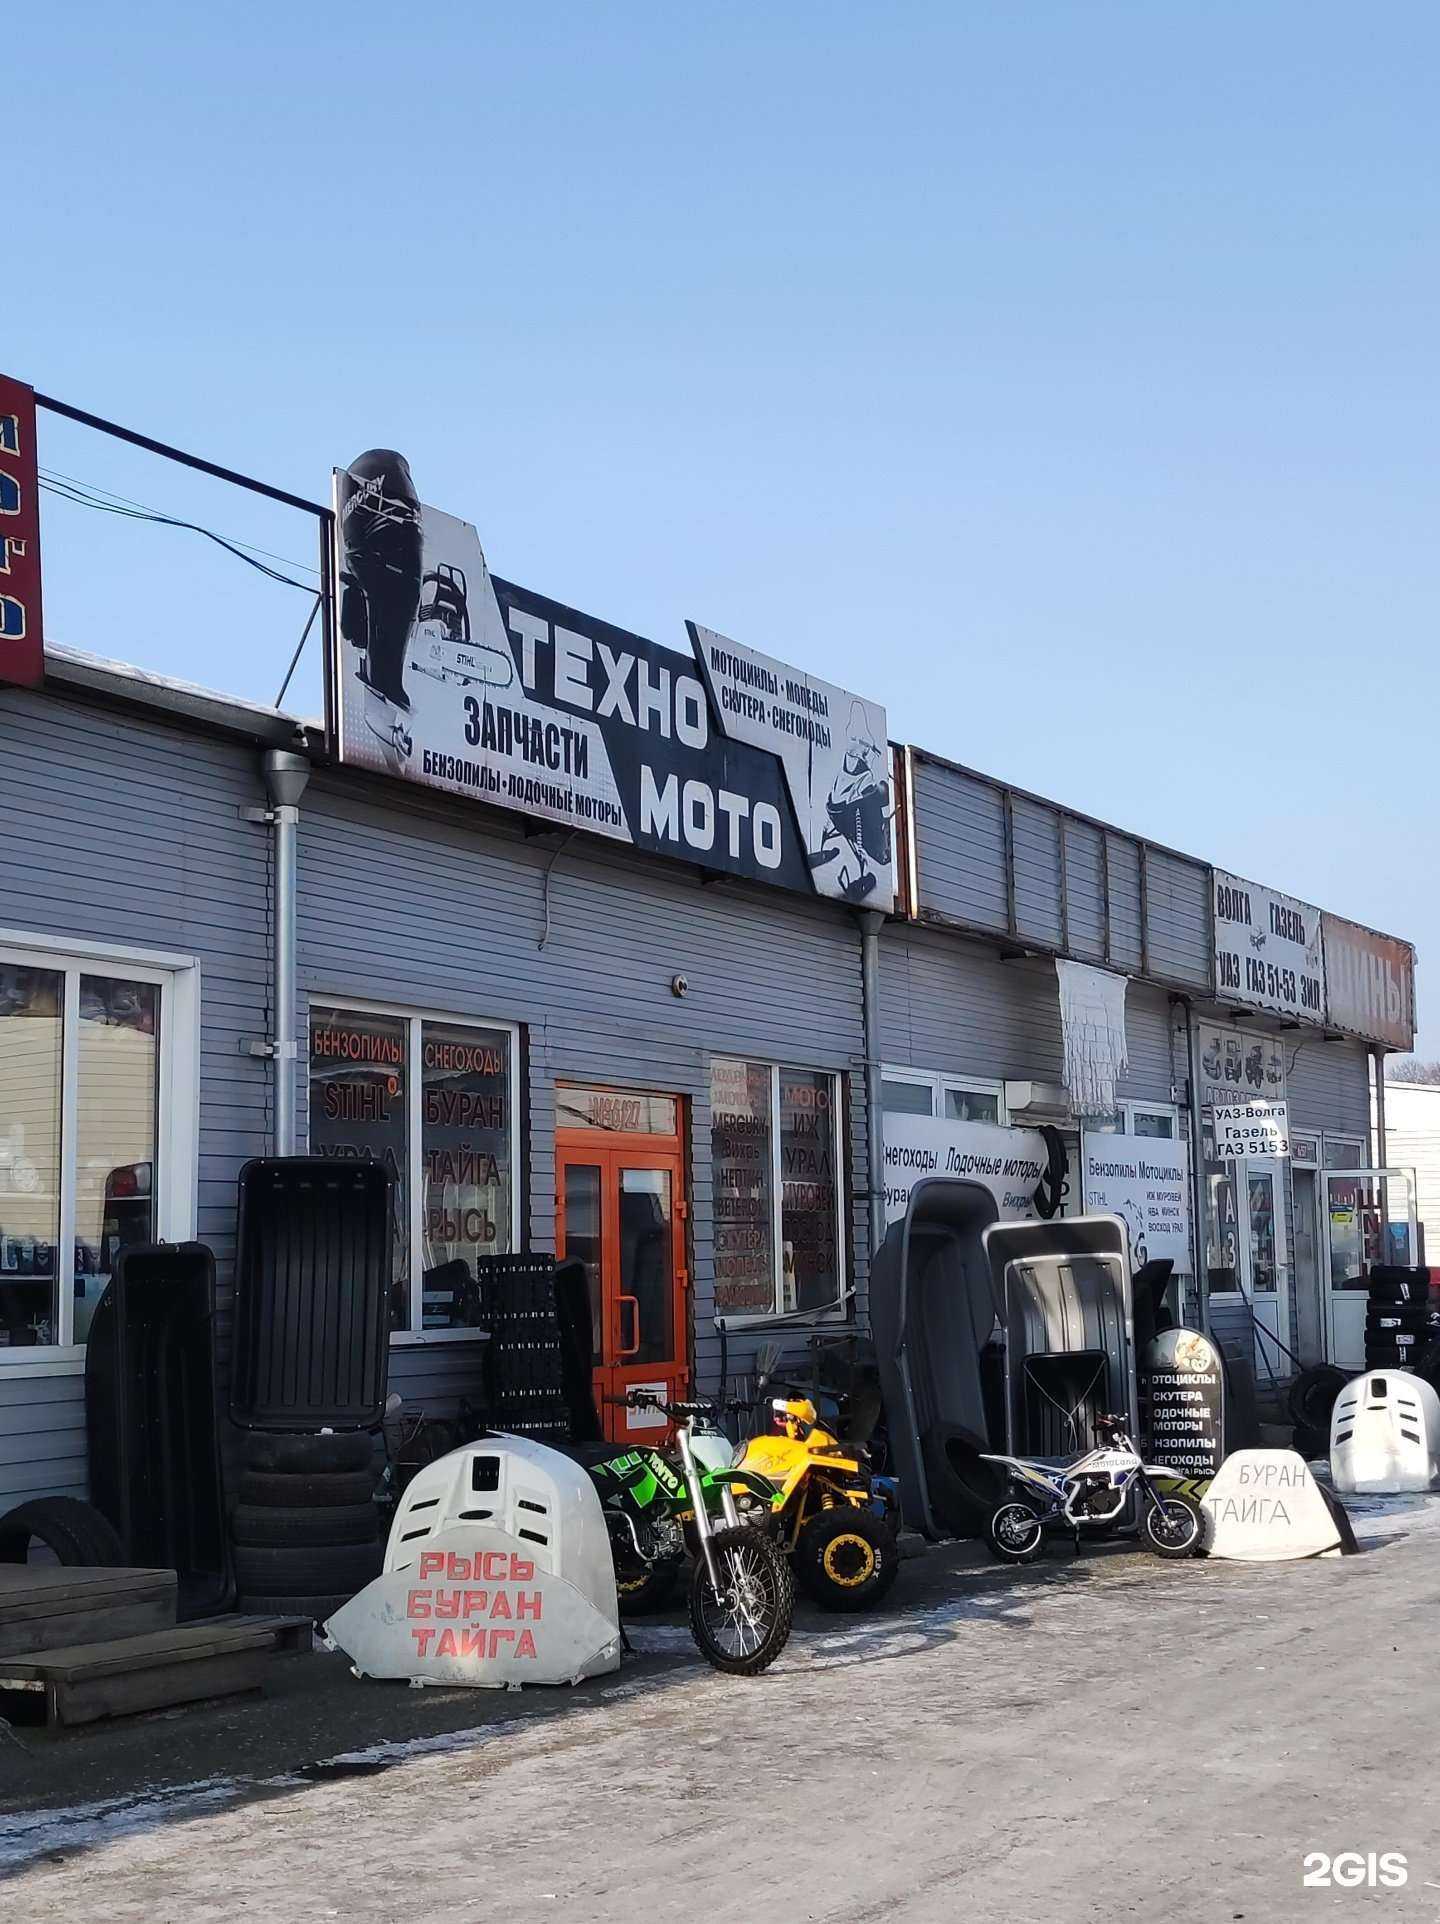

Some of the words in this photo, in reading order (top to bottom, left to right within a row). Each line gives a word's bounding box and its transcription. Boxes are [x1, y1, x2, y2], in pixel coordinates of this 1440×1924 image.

[508, 606, 708, 750] ТЕХНО
[710, 646, 779, 696] МОТОЦИКЛЫ
[785, 679, 829, 718] МОПЕДЫ
[721, 685, 766, 724] СКУТЕРА
[772, 705, 832, 749] СНЕГОХОДЫ
[463, 695, 589, 780] ЗАПЧАСТИ
[423, 749, 501, 793] БЕНЗОПИЛЫ
[507, 773, 574, 814] ЛОДОЧНЫЕ
[574, 793, 622, 827] МОТОРЫ
[640, 764, 782, 869] МОТО
[1216, 884, 1252, 926] ВОЛГА
[1268, 901, 1306, 946] ГАЗЕЛЬ
[1218, 950, 1241, 989] УАЗ
[1245, 956, 1266, 995] ГАЗ
[1267, 963, 1297, 1004] 51-53
[1299, 973, 1321, 1013] ЗИЛ
[314, 1029, 404, 1064] БЕНЗОПИЛЫ
[424, 1043, 504, 1077] СНЕГОХОДЫ
[322, 1081, 392, 1123] STIHL
[425, 1089, 505, 1130] БУРАН
[1215, 1107, 1286, 1120] УАЗ-Волга
[793, 1112, 820, 1140] ИЖ
[1225, 1127, 1278, 1139] Газель
[785, 1146, 833, 1177] УРАЛ
[945, 1145, 1003, 1176] Лодочные
[1002, 1157, 1044, 1183] моторы
[1217, 1142, 1245, 1156] ГАЗ
[1249, 1139, 1289, 1154] 5153
[427, 1143, 502, 1187] ТАЙГА
[1088, 1157, 1137, 1179] Бензопилы
[1138, 1161, 1184, 1183] Мотоциклы
[1088, 1191, 1108, 1206] STIHL
[428, 1207, 497, 1244] РЫСЬ
[1153, 1391, 1204, 1402] СКУТЕРА
[1153, 1408, 1211, 1419] ОДОЧНЫЕ
[1153, 1421, 1203, 1431] МОТОРЫ
[1141, 1438, 1216, 1449] БНЗОПИЛЫ
[1239, 1464, 1306, 1488] БУРАН
[1208, 1494, 1292, 1526] ТАЙГА
[419, 1551, 535, 1582] РЫСЬ
[406, 1589, 543, 1620] БУРАН
[411, 1622, 538, 1659] ТАЙГА
